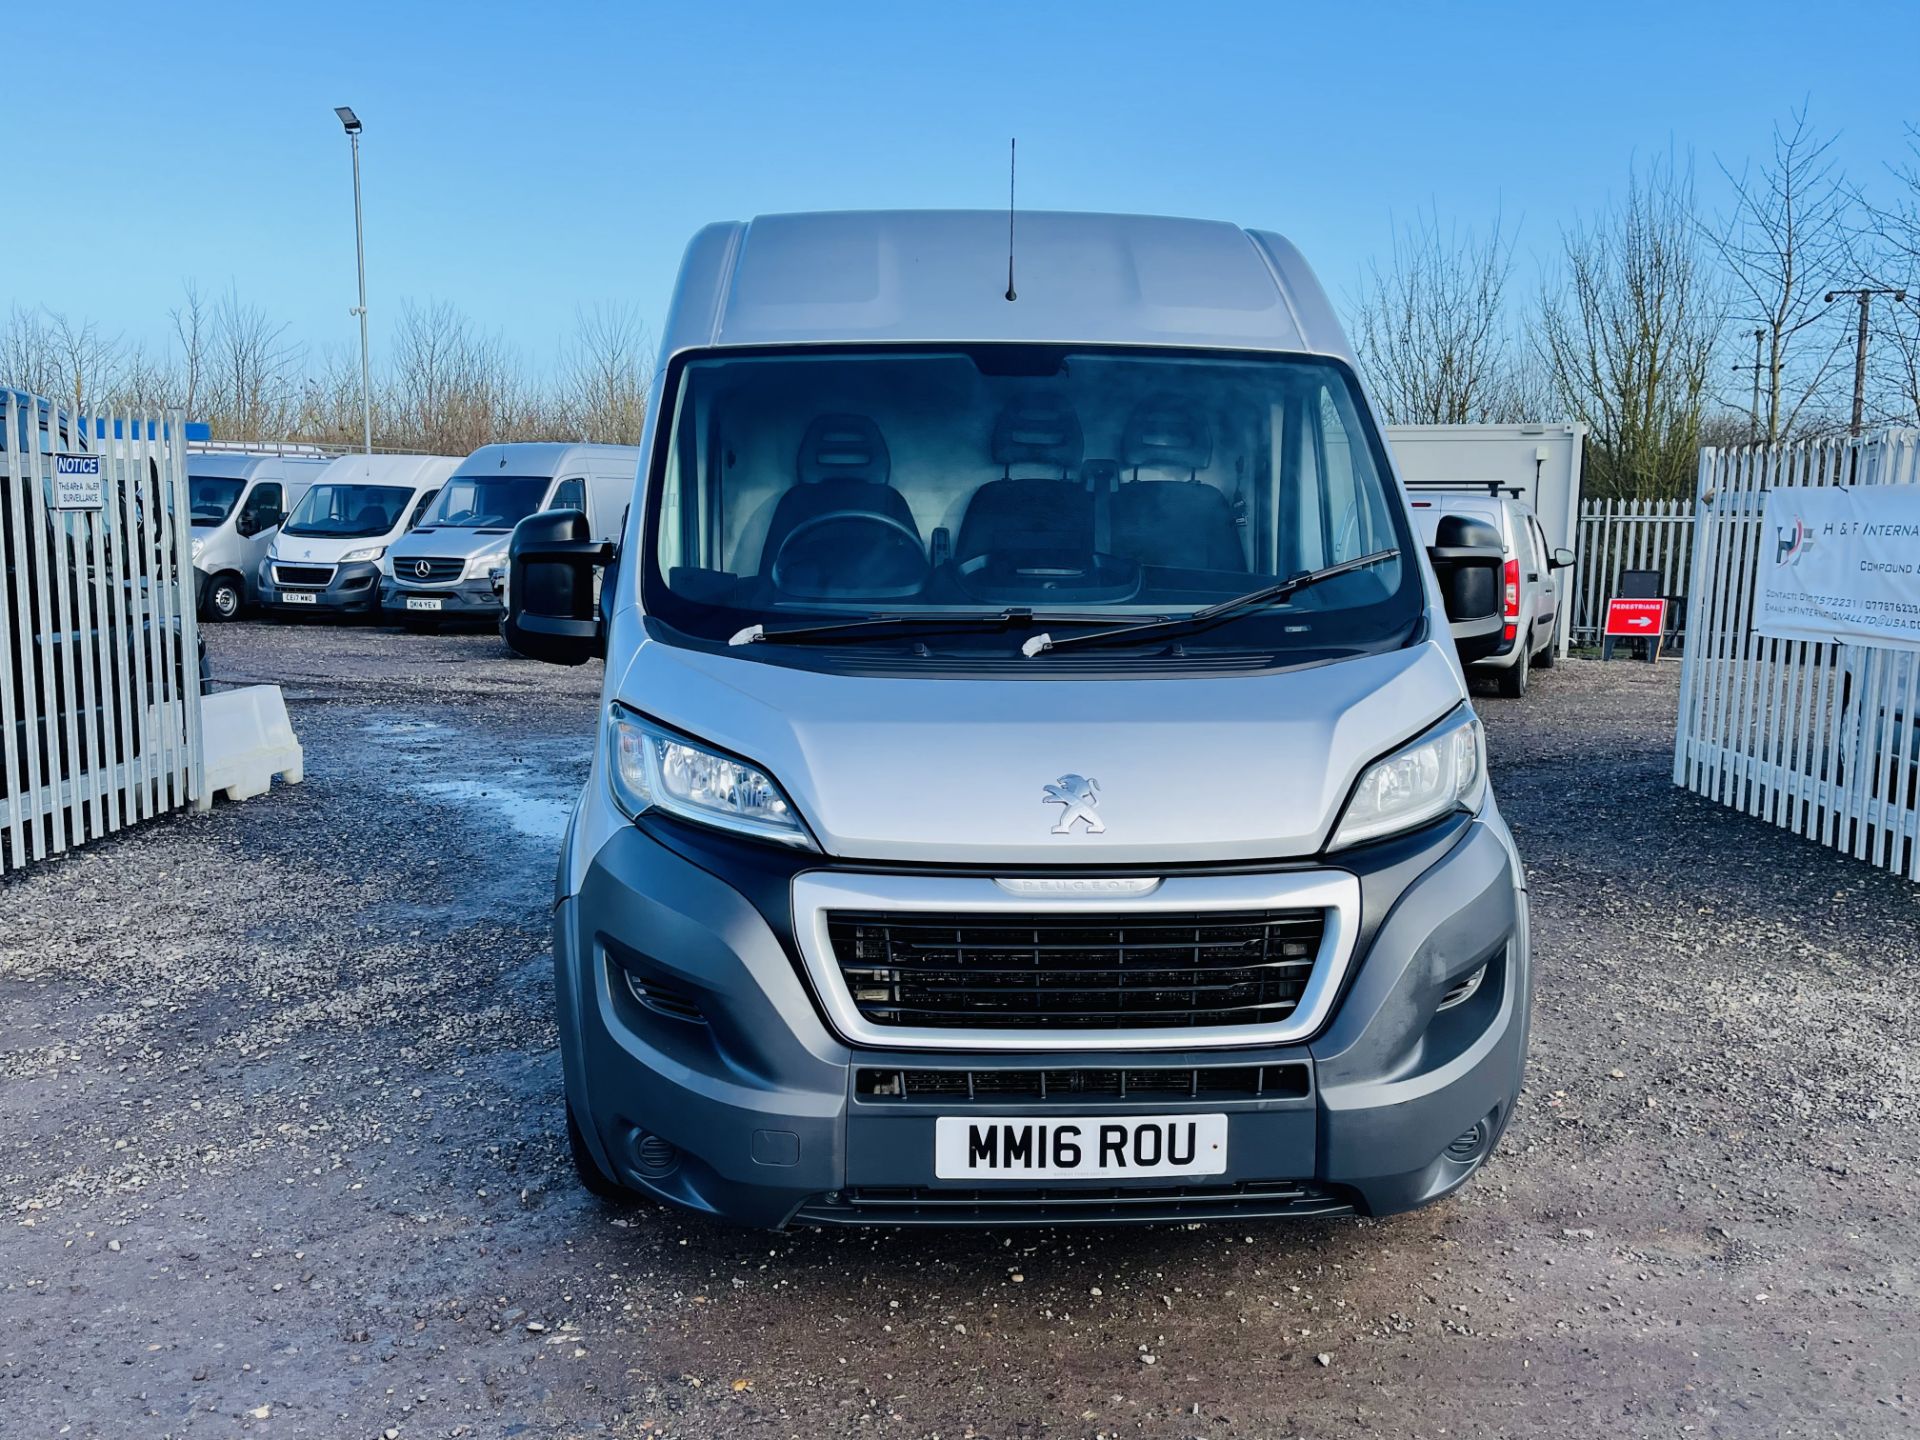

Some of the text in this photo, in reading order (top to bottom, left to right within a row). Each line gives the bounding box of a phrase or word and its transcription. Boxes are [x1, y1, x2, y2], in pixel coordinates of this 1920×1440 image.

[58, 457, 96, 473] NOTICE
[1823, 522, 1834, 535] H
[1840, 522, 1848, 535] &
[1853, 522, 1859, 535] F
[1860, 560, 1913, 574] COMPOUND
[1022, 880, 1135, 891] PEUGEOT
[968, 1122, 1196, 1168] MM16 ROU
